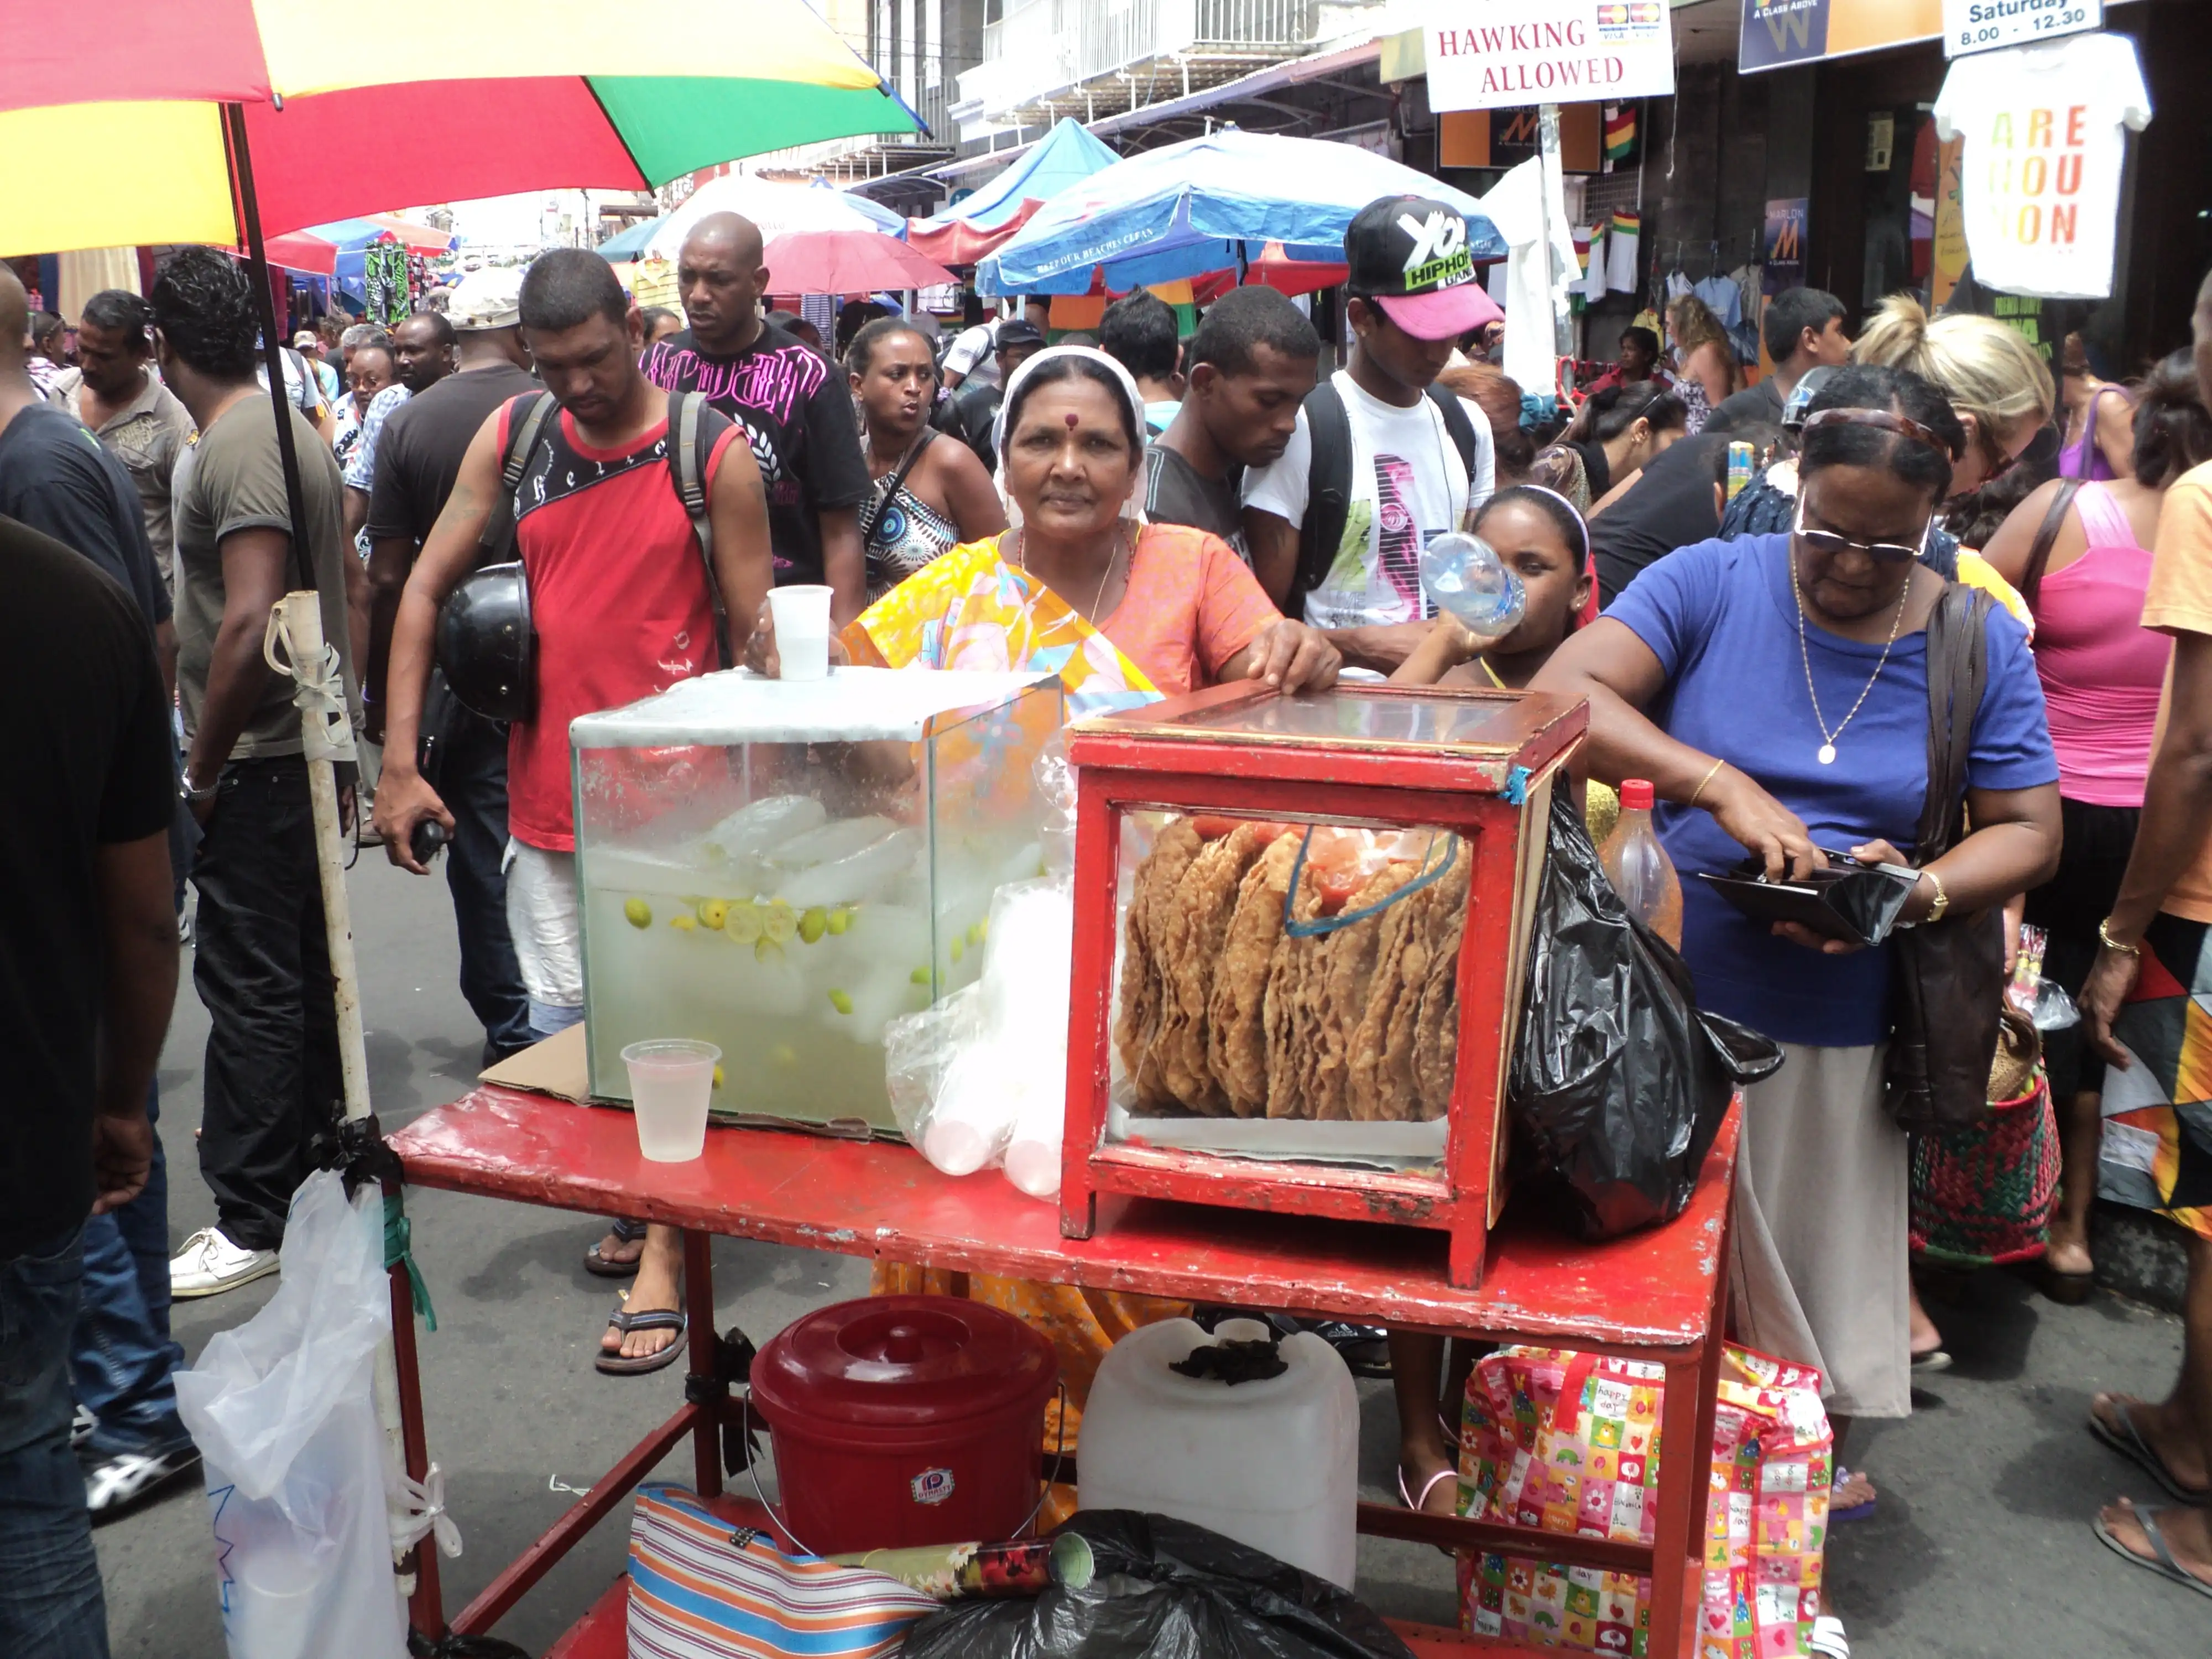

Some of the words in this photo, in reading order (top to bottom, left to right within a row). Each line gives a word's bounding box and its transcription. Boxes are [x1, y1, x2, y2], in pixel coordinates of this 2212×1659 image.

[1753, 9, 1761, 19] A
[1762, 4, 1789, 17] CLASS
[1790, 0, 1818, 11] ABOVE
[1960, 27, 2000, 46] 8.00
[2033, 8, 2085, 31] 12.30
[1969, 0, 2069, 23] Saturday
[1438, 19, 1585, 57] HAWKING
[1480, 56, 1624, 93] ALLOWED
[1991, 104, 2087, 149] ARE
[1769, 209, 1804, 219] MARLON
[1060, 252, 1081, 265] OUR
[1082, 238, 1122, 259] BEACHES
[1123, 228, 1154, 244] CLEAN
[1411, 247, 1470, 286] HIPHOP
[918, 1484, 951, 1499] DYNASTY
